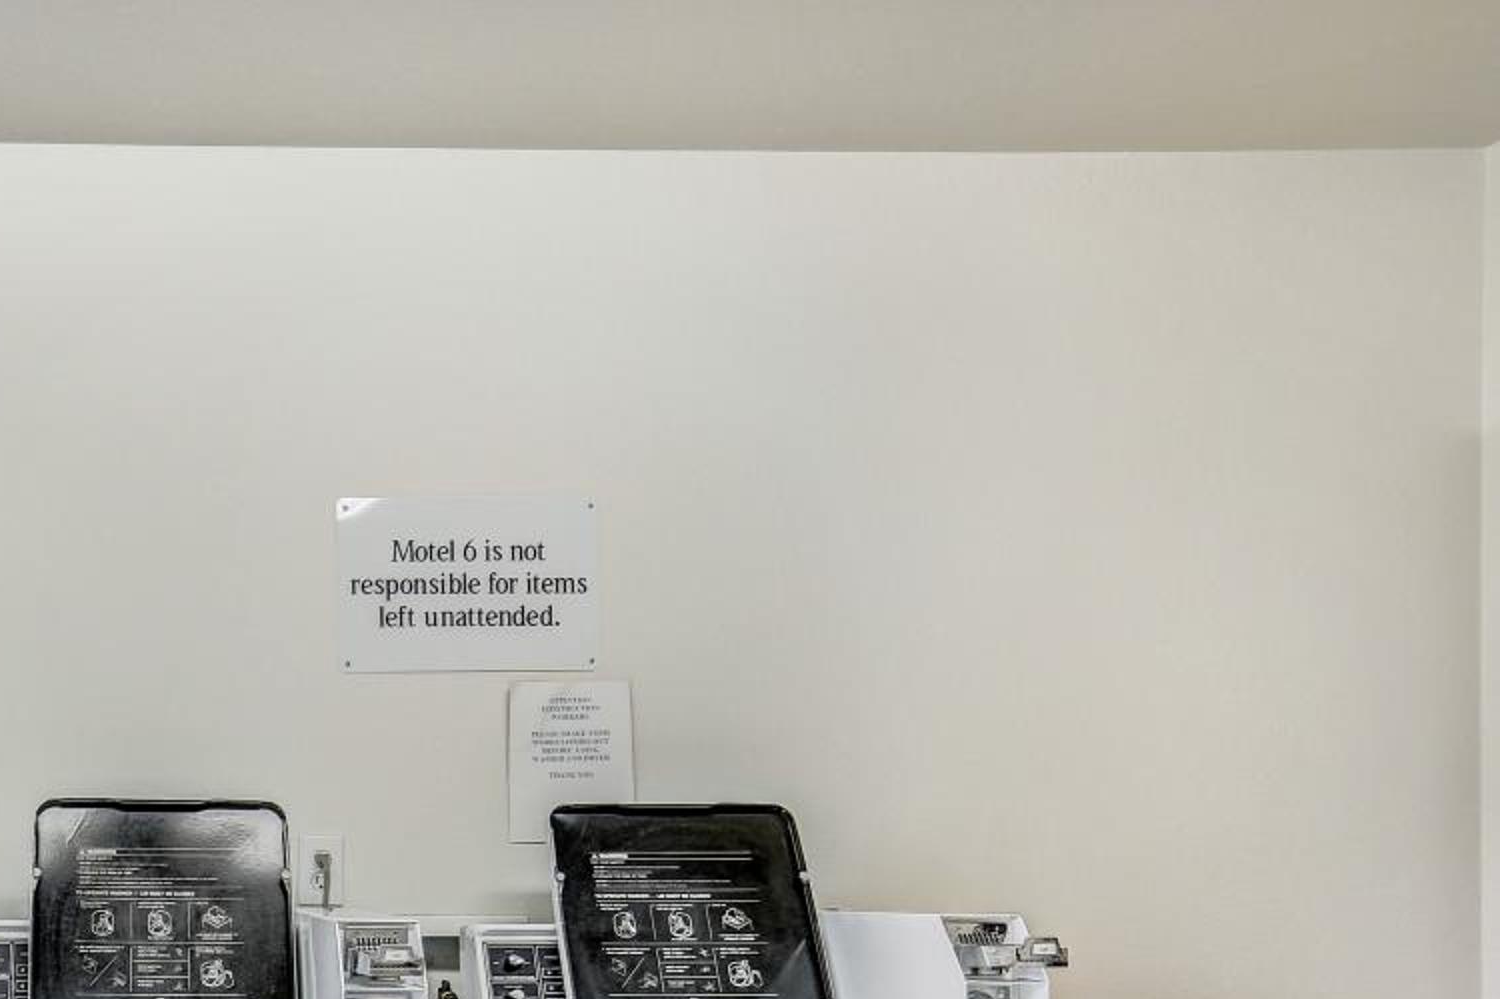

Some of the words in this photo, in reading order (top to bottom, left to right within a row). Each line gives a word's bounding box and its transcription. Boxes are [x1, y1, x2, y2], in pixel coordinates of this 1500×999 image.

[391, 539, 456, 562] Motel
[463, 538, 477, 562] 6
[484, 539, 503, 561] is
[510, 542, 546, 561] not
[350, 572, 481, 601] responsible
[488, 572, 518, 594] for
[526, 572, 588, 594] items
[378, 606, 415, 628] left
[424, 605, 561, 628] unattended.
